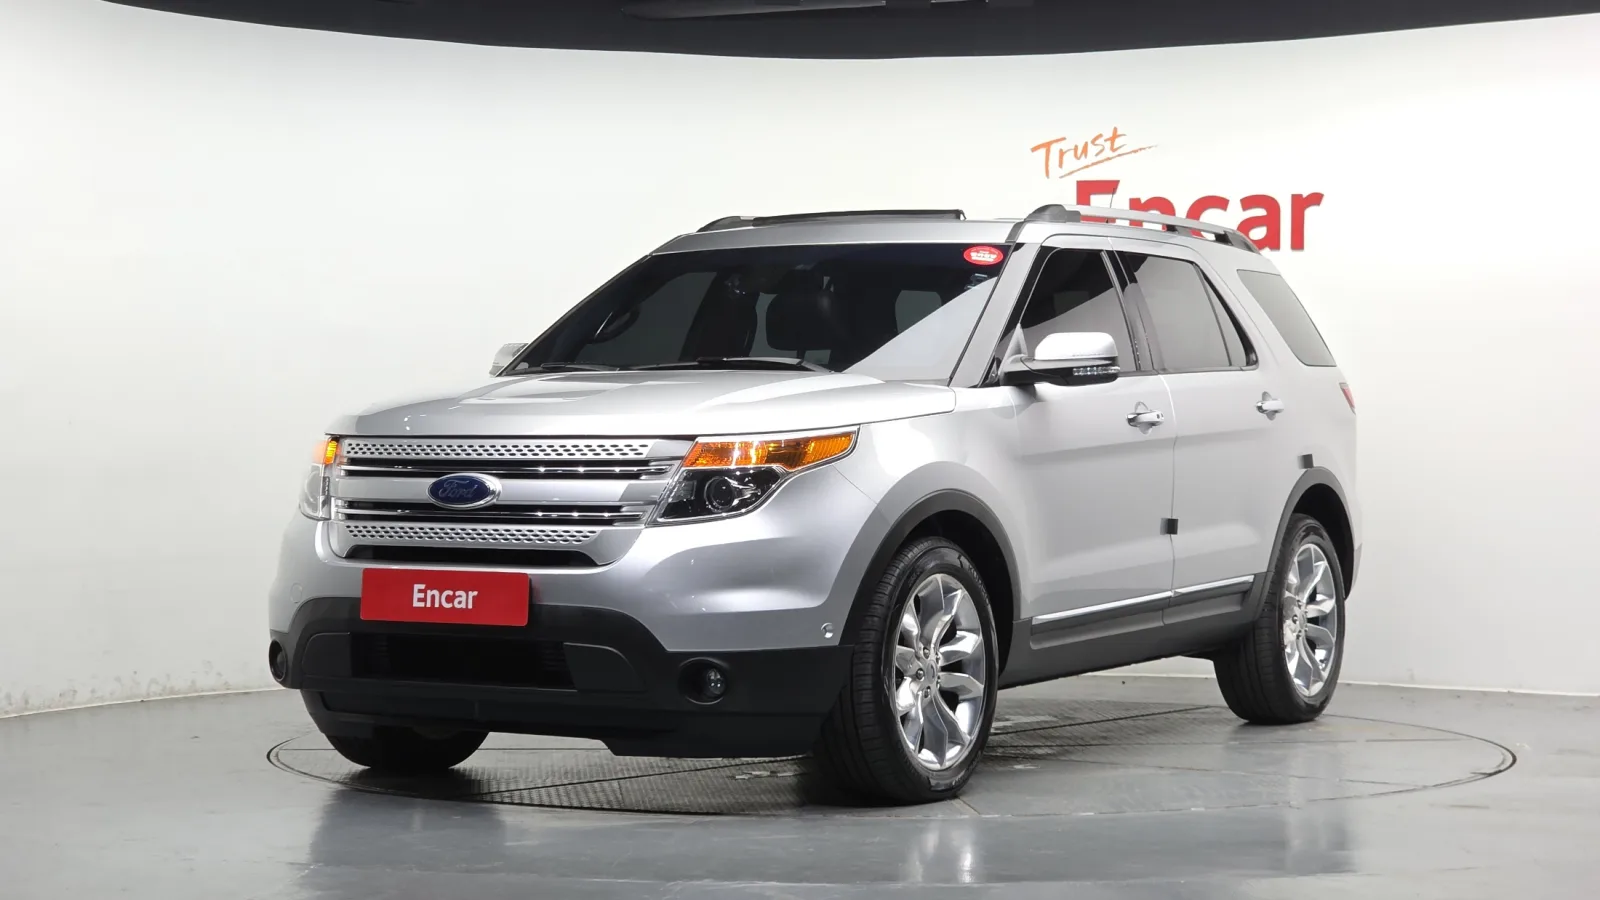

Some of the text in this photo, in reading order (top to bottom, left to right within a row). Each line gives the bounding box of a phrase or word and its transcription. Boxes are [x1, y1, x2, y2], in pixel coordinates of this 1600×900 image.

[1030, 126, 1127, 179] Trust
[438, 479, 479, 498] Ford
[412, 583, 479, 609] Encar
